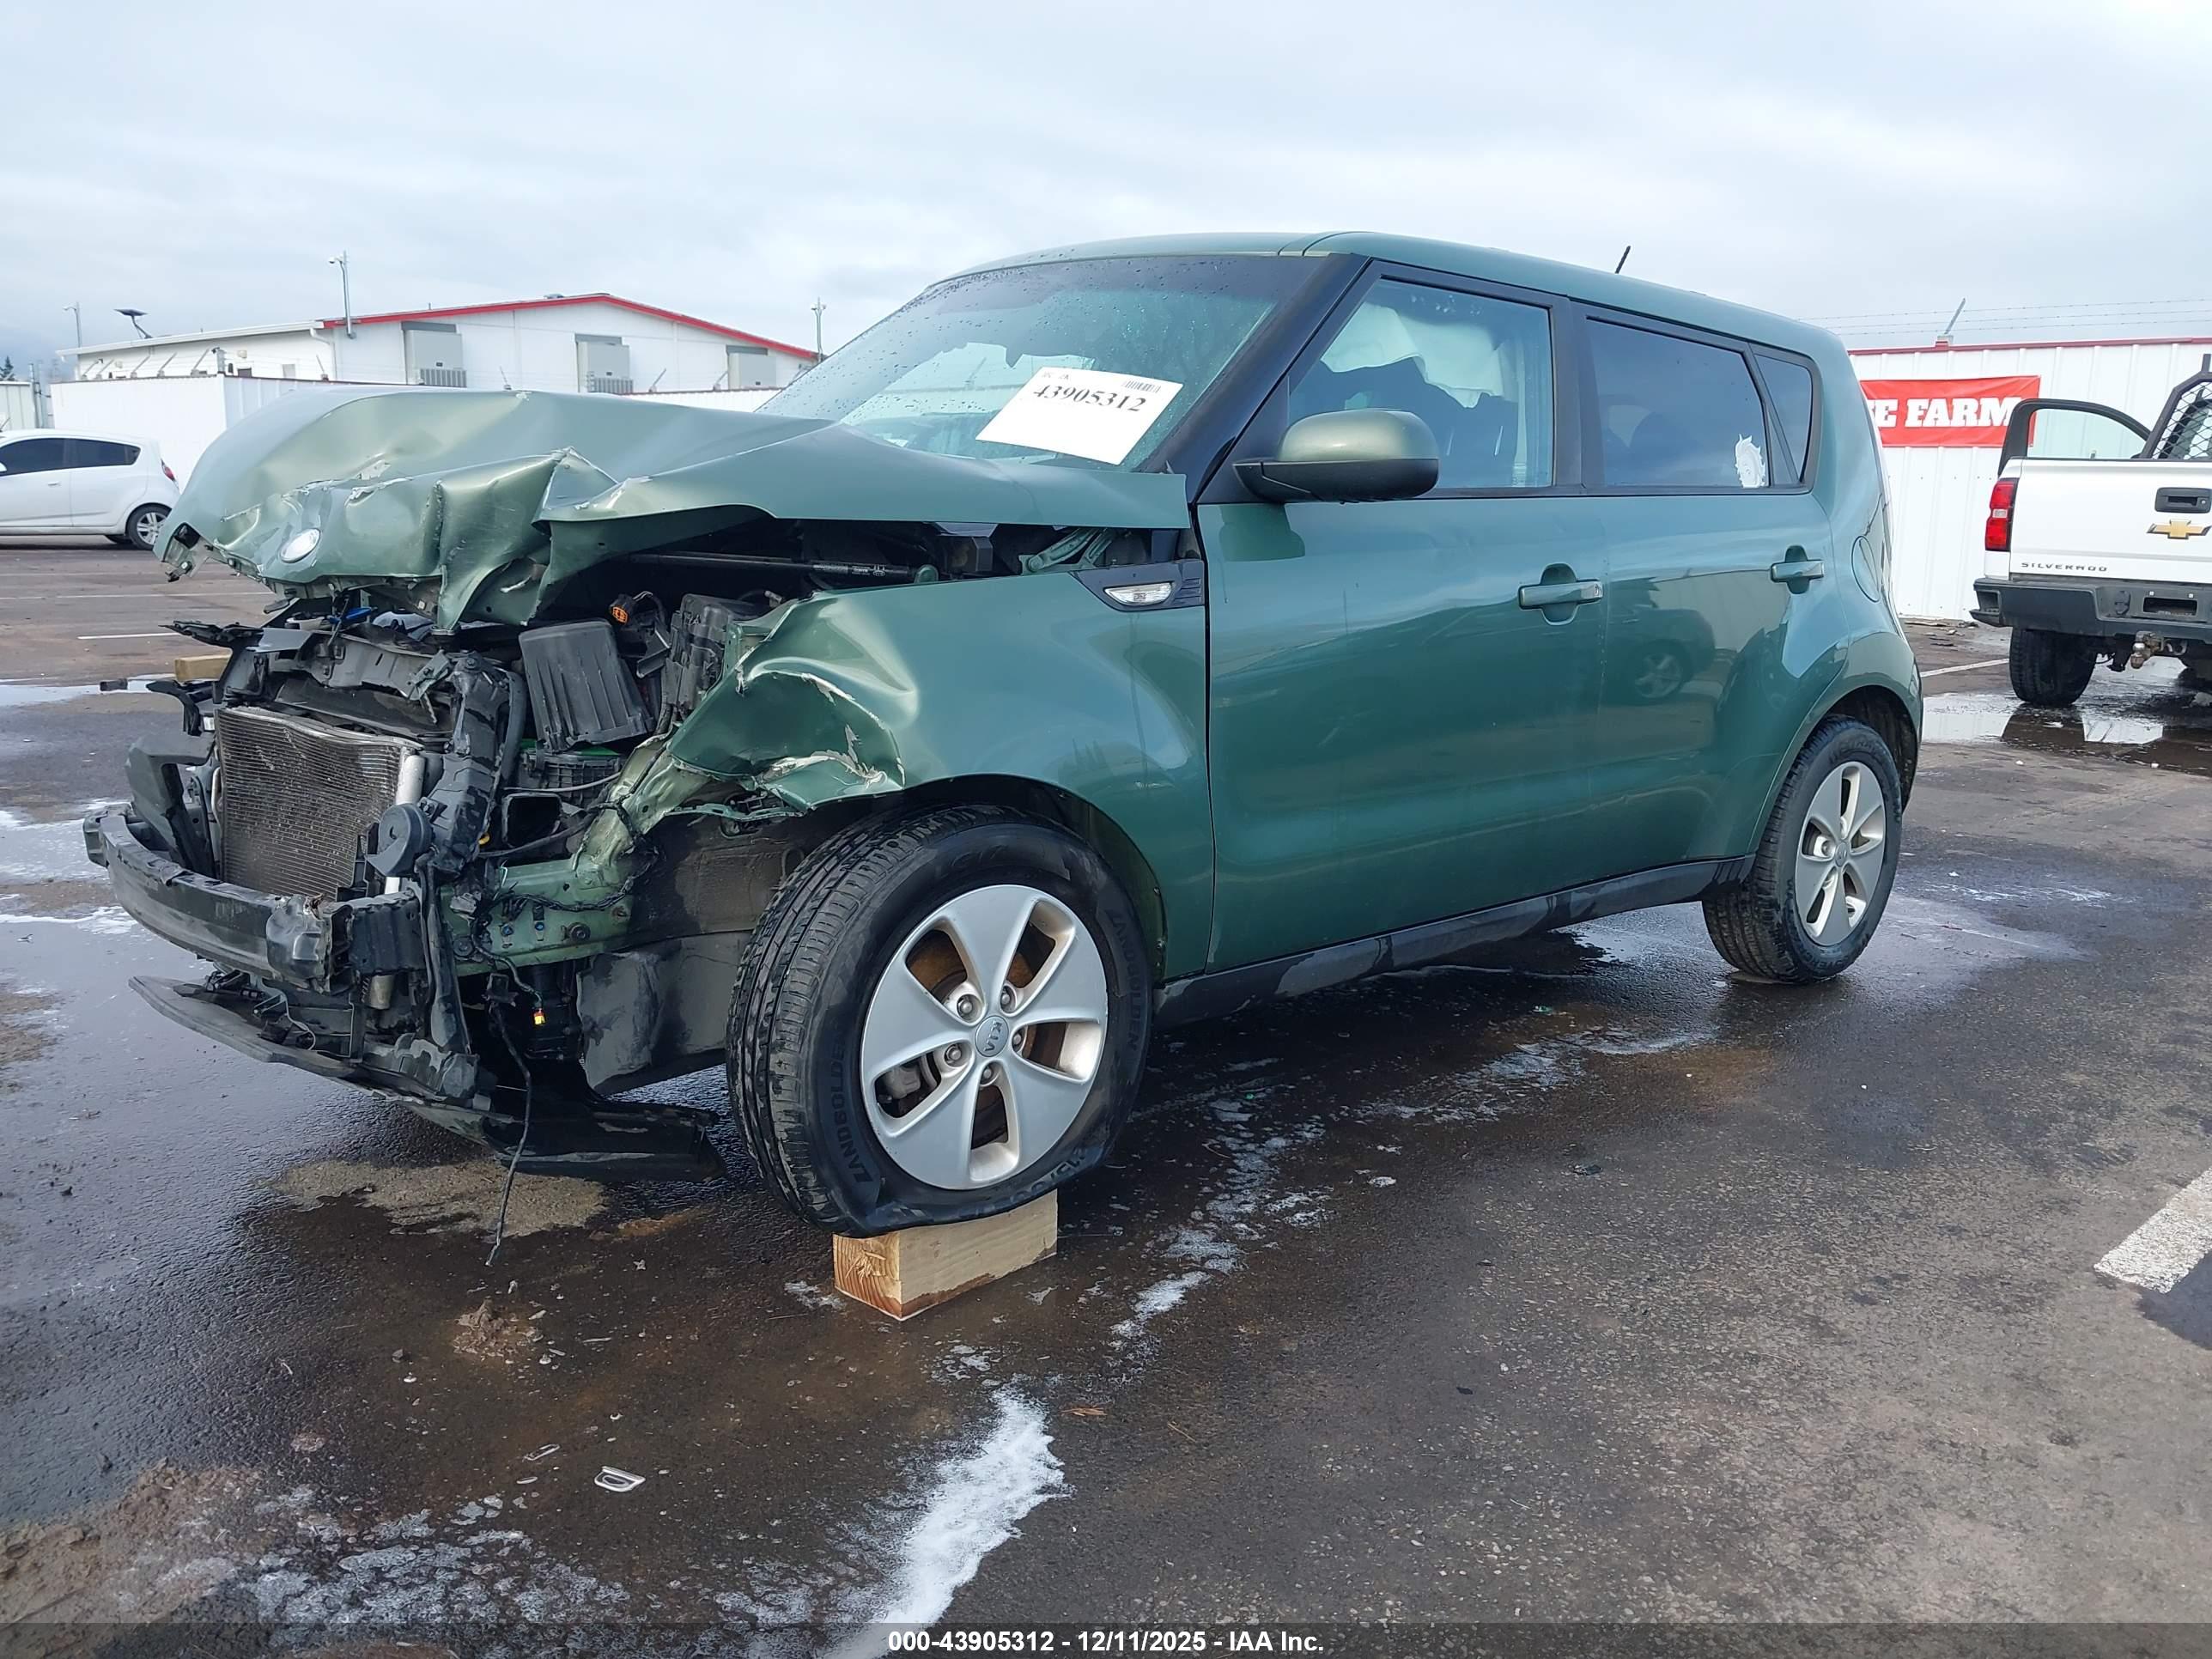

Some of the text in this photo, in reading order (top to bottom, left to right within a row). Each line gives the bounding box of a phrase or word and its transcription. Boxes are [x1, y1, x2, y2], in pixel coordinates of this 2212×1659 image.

[1033, 384, 1147, 412] 43905312
[1904, 396, 2021, 428] FARM
[2021, 562, 2108, 573] SILVERADO
